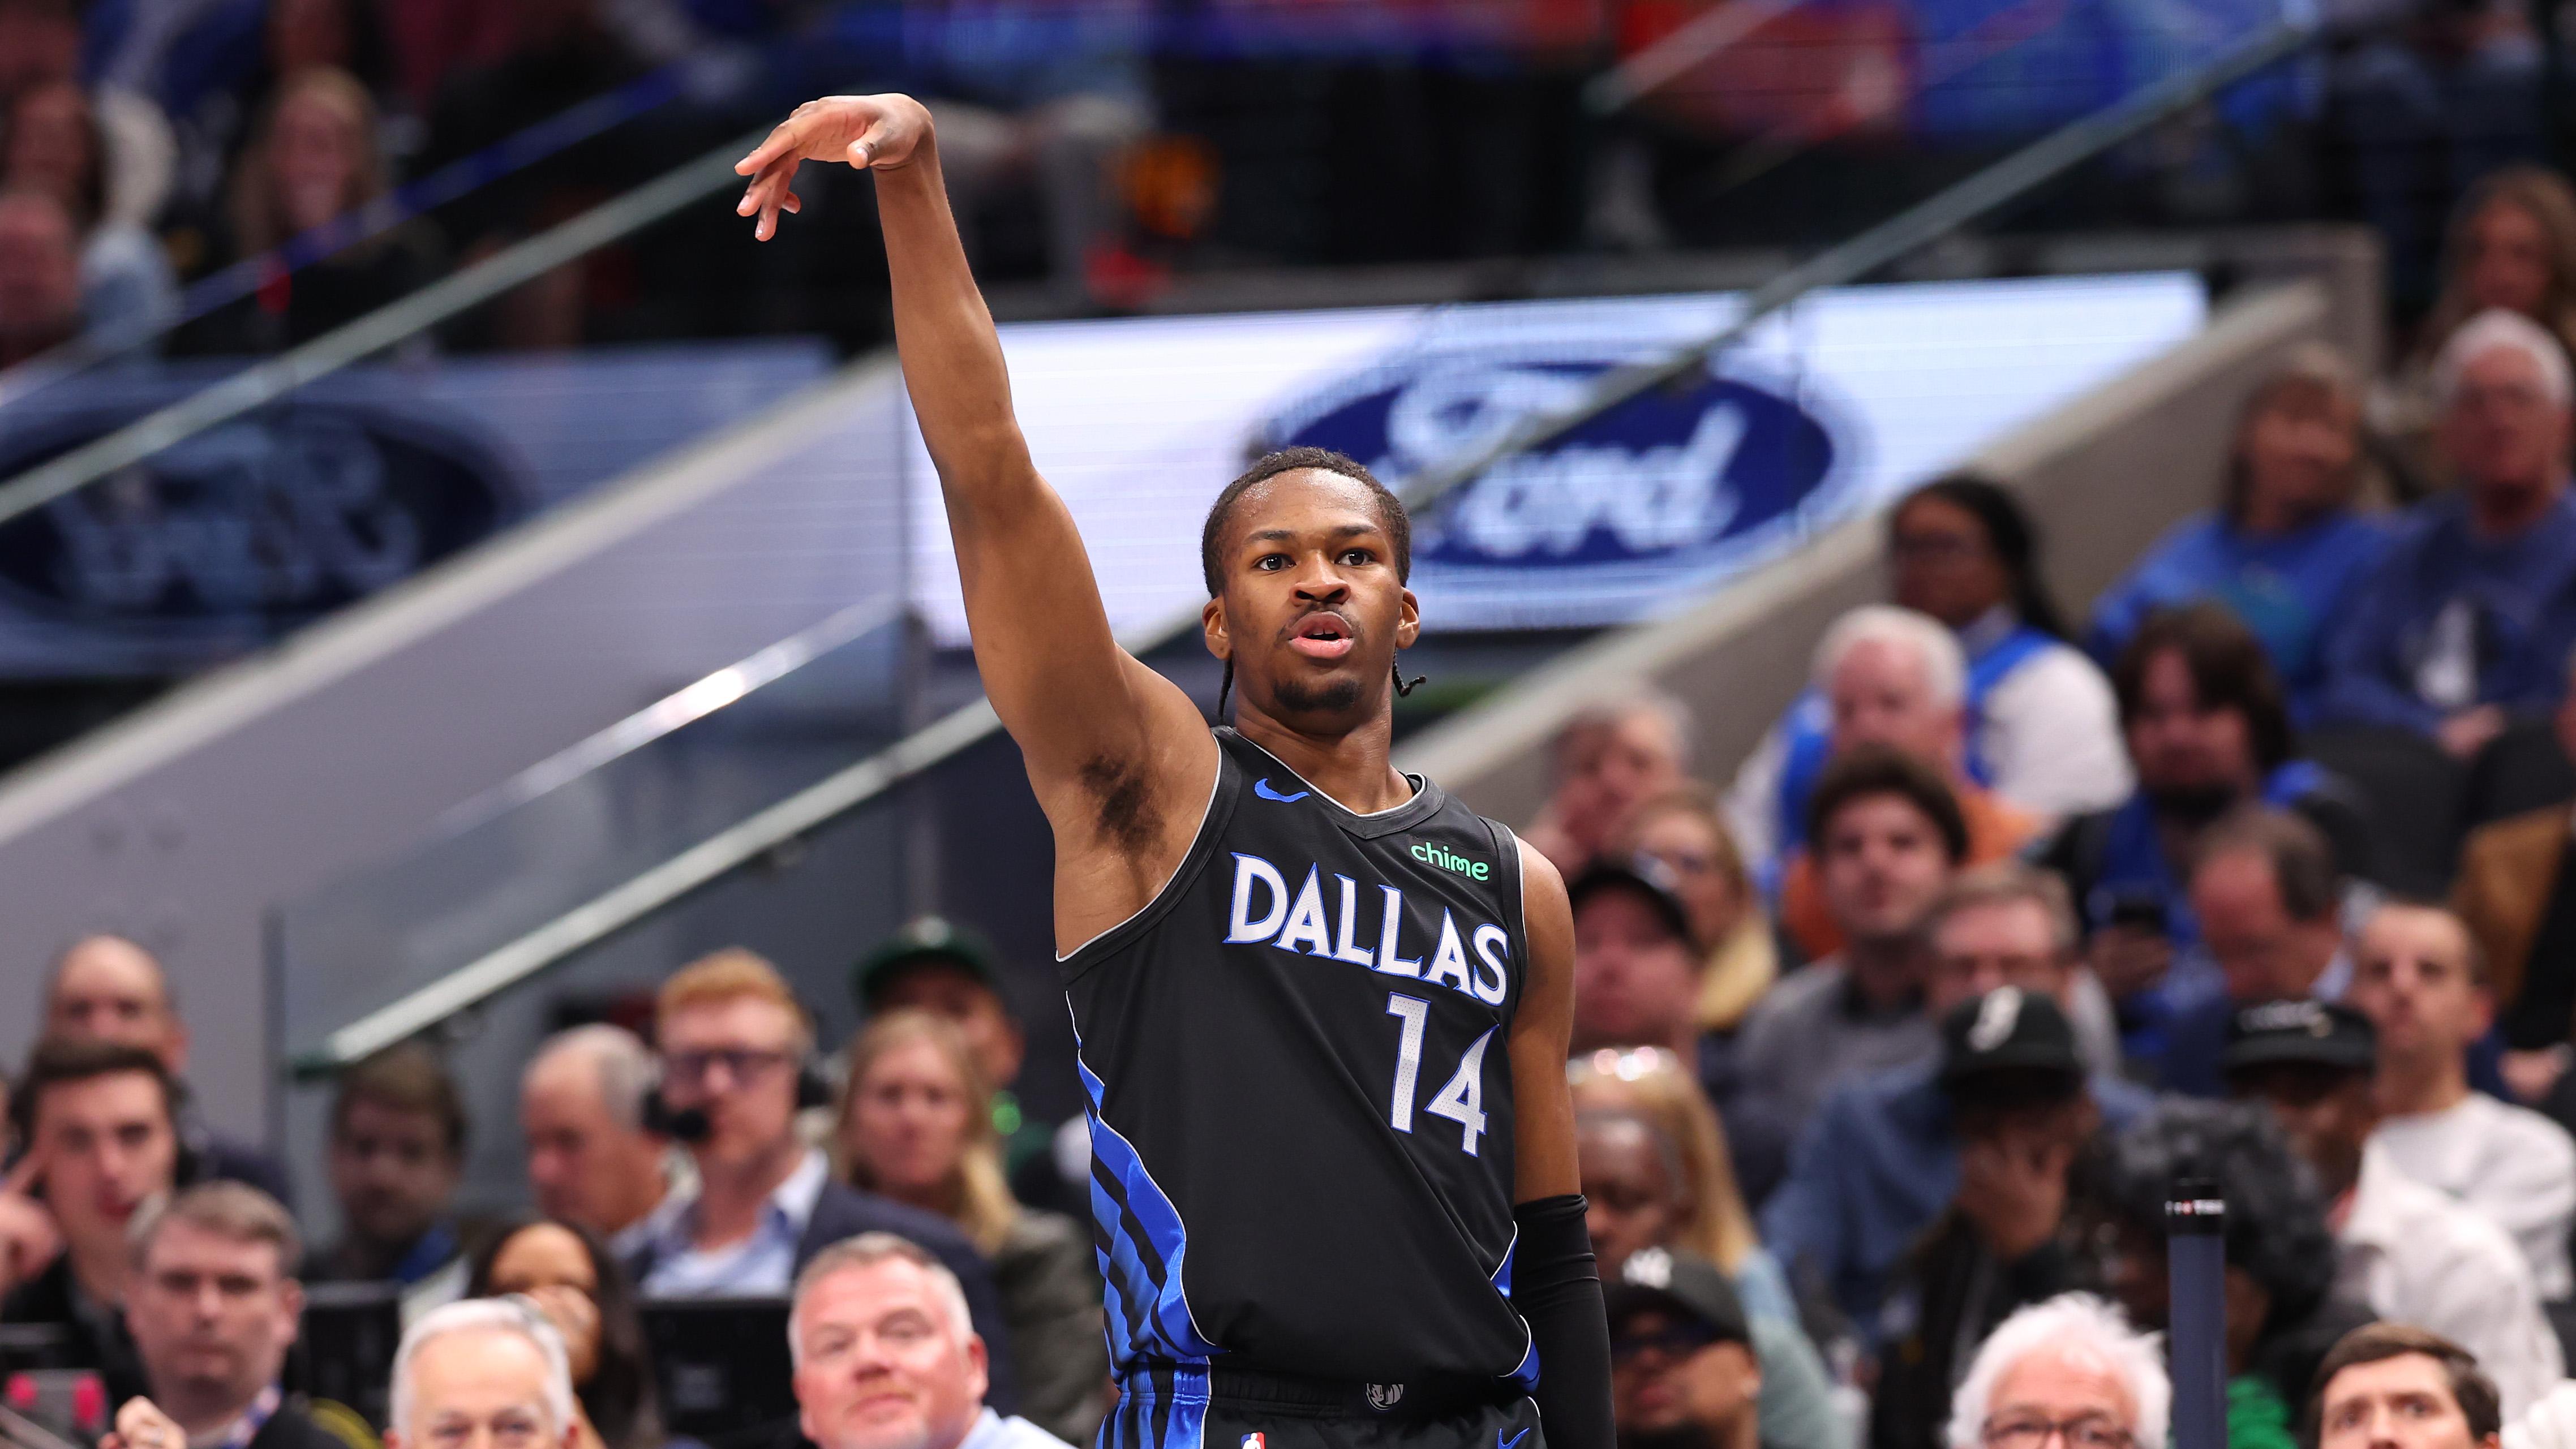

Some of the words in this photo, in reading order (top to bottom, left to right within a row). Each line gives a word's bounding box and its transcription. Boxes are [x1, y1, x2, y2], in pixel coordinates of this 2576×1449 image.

[1367, 360, 1746, 557] Ford
[1222, 852, 1509, 1007] DALLAS
[1411, 842, 1489, 881] chime
[1386, 991, 1500, 1157] 14
